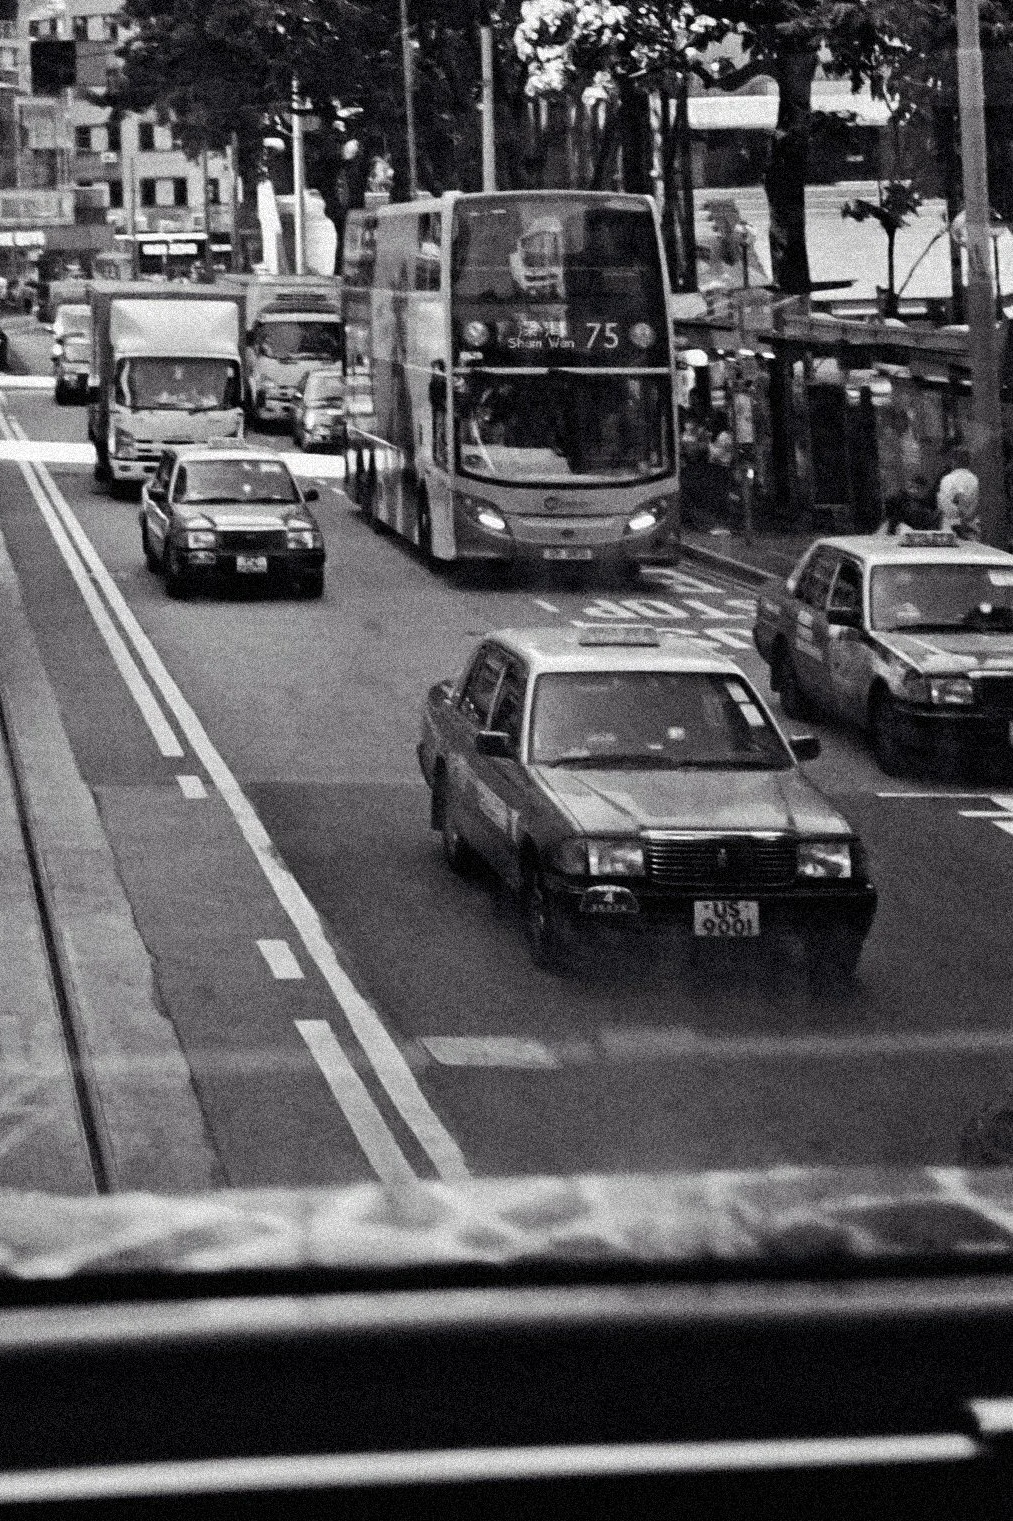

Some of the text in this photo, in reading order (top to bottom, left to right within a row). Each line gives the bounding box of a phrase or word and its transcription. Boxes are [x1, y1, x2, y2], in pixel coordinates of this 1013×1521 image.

[547, 337, 576, 349] Wan
[586, 322, 620, 349] 75
[713, 901, 741, 919] US
[702, 917, 753, 936] 9001
